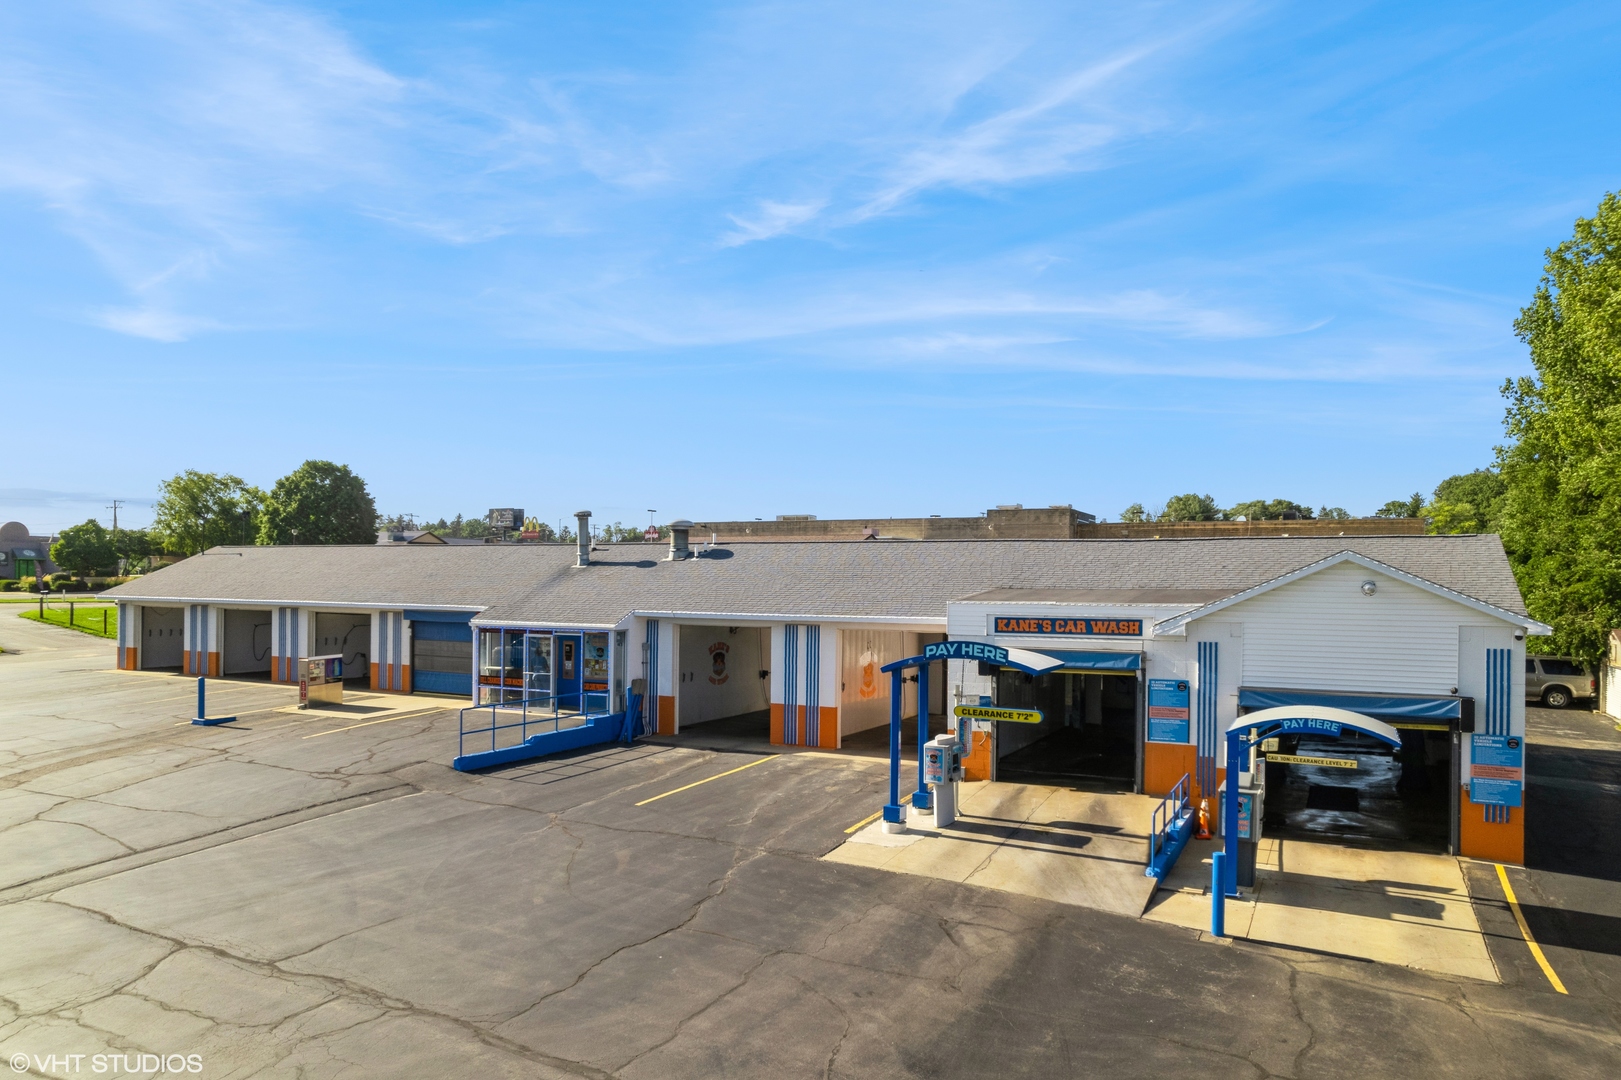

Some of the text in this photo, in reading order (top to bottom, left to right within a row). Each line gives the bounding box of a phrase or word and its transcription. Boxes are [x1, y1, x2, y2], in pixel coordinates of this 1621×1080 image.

[998, 619, 1140, 634] KANE'S CAR WASH
[926, 644, 1006, 662] PAY HERE
[962, 708, 1014, 719] CLEARANCE
[1283, 718, 1339, 732] PAY HERE
